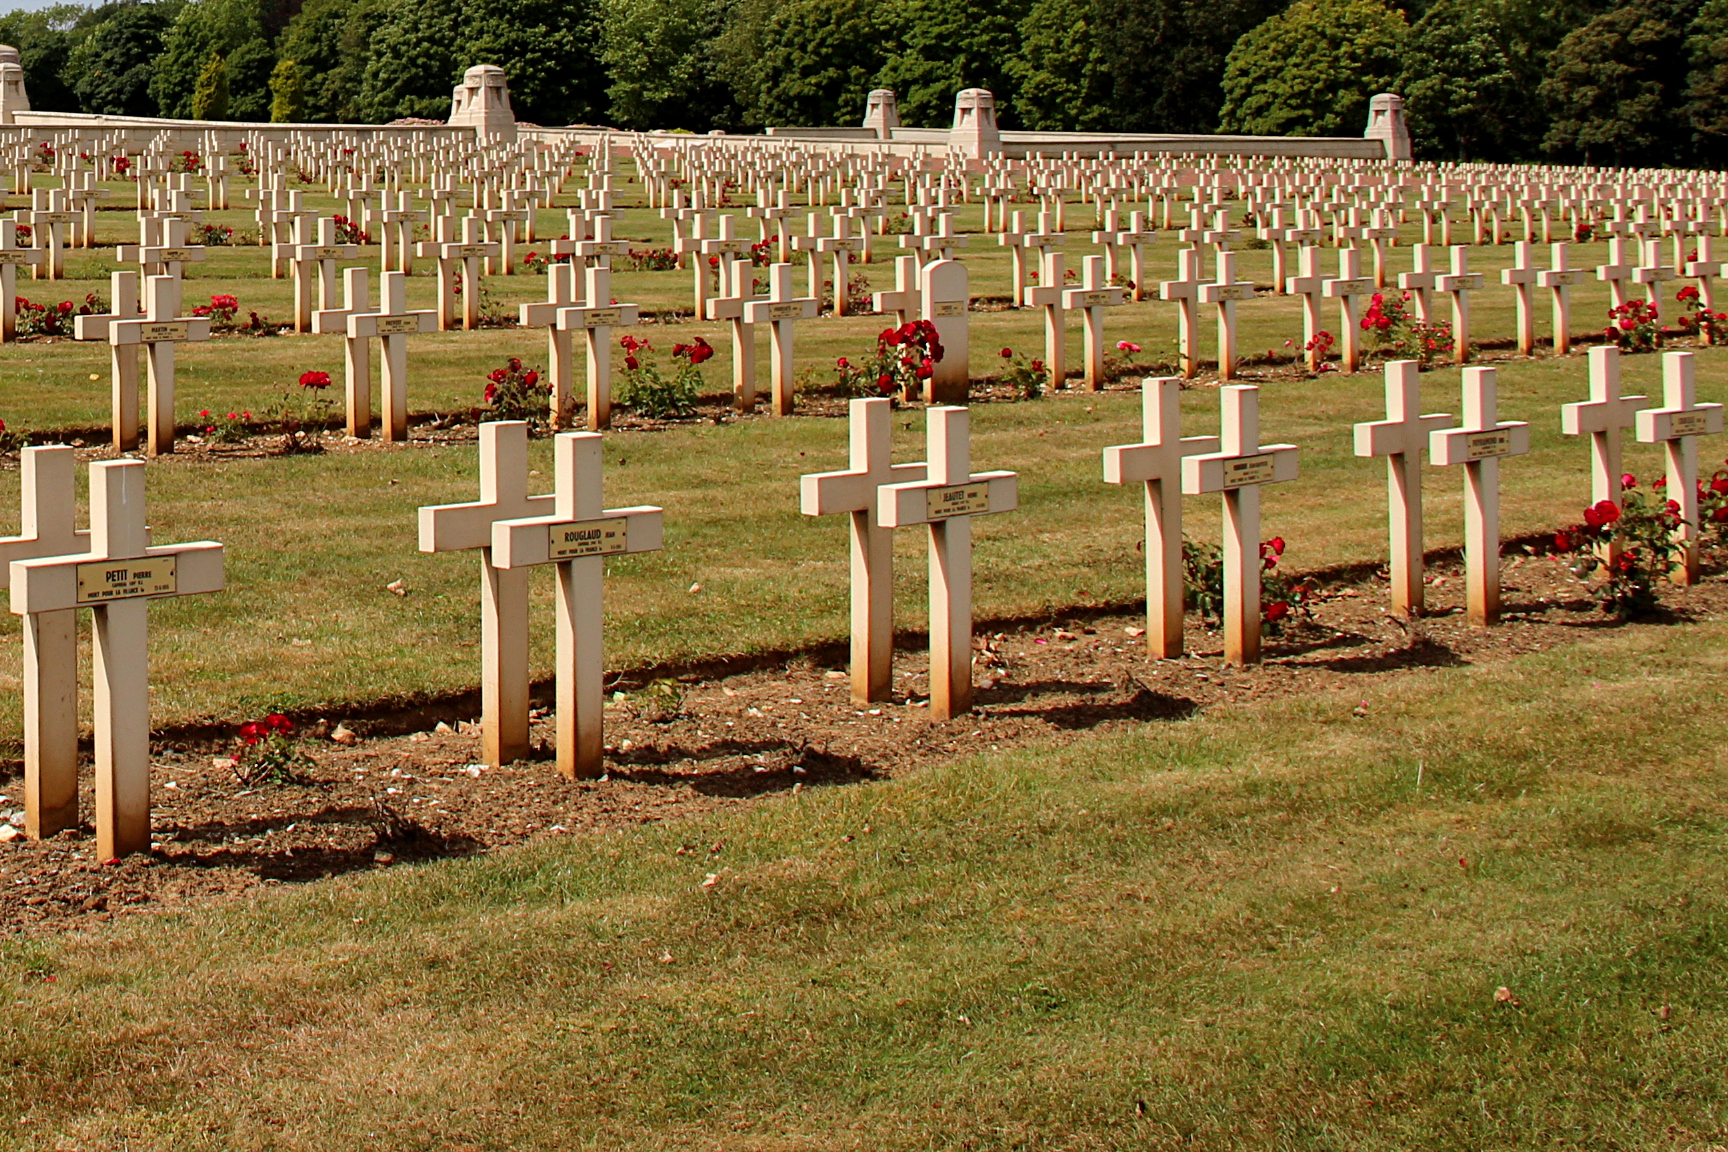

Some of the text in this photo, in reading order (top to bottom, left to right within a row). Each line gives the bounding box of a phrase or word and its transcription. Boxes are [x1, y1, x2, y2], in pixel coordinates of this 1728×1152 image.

[565, 529, 601, 542] ROUGLAUD
[106, 570, 151, 582] PETIT PIERRE
